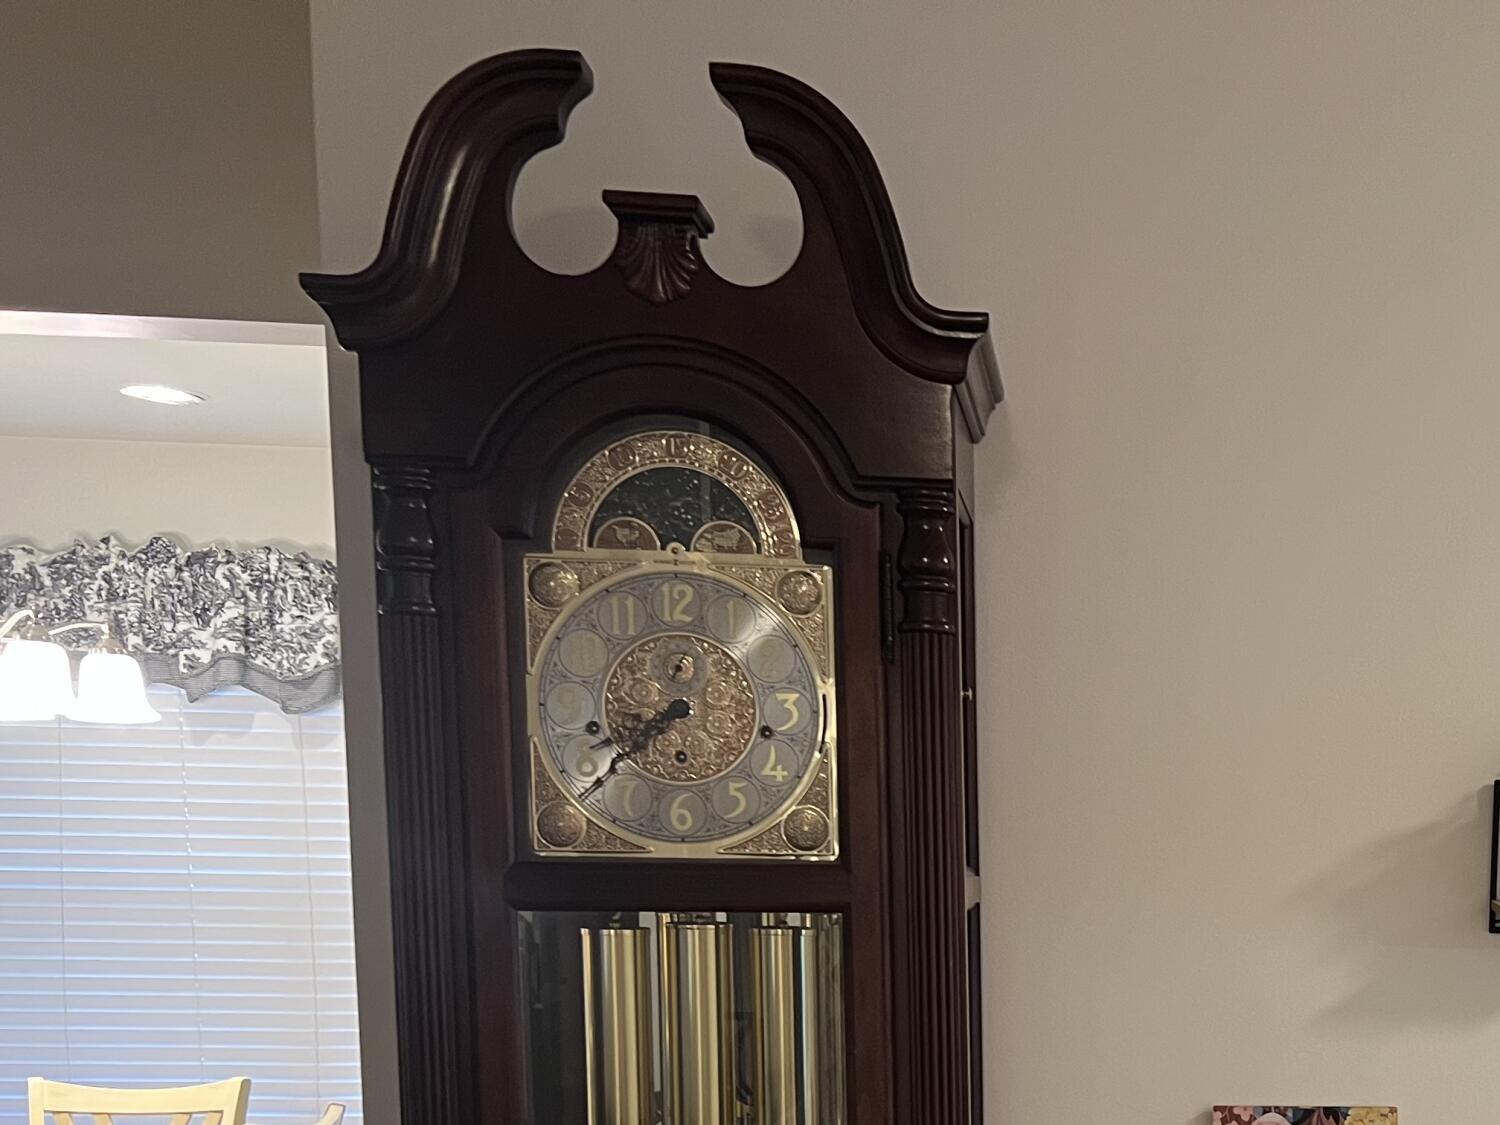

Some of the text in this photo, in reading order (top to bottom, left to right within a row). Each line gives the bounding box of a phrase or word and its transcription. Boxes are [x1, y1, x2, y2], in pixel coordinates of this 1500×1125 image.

[611, 596, 636, 635] 11
[662, 582, 694, 623] 12
[726, 602, 737, 639] 1
[775, 693, 799, 731] 3
[761, 744, 789, 782] 4
[614, 780, 637, 816] 7
[670, 793, 693, 831] 6
[725, 782, 748, 818] 5
